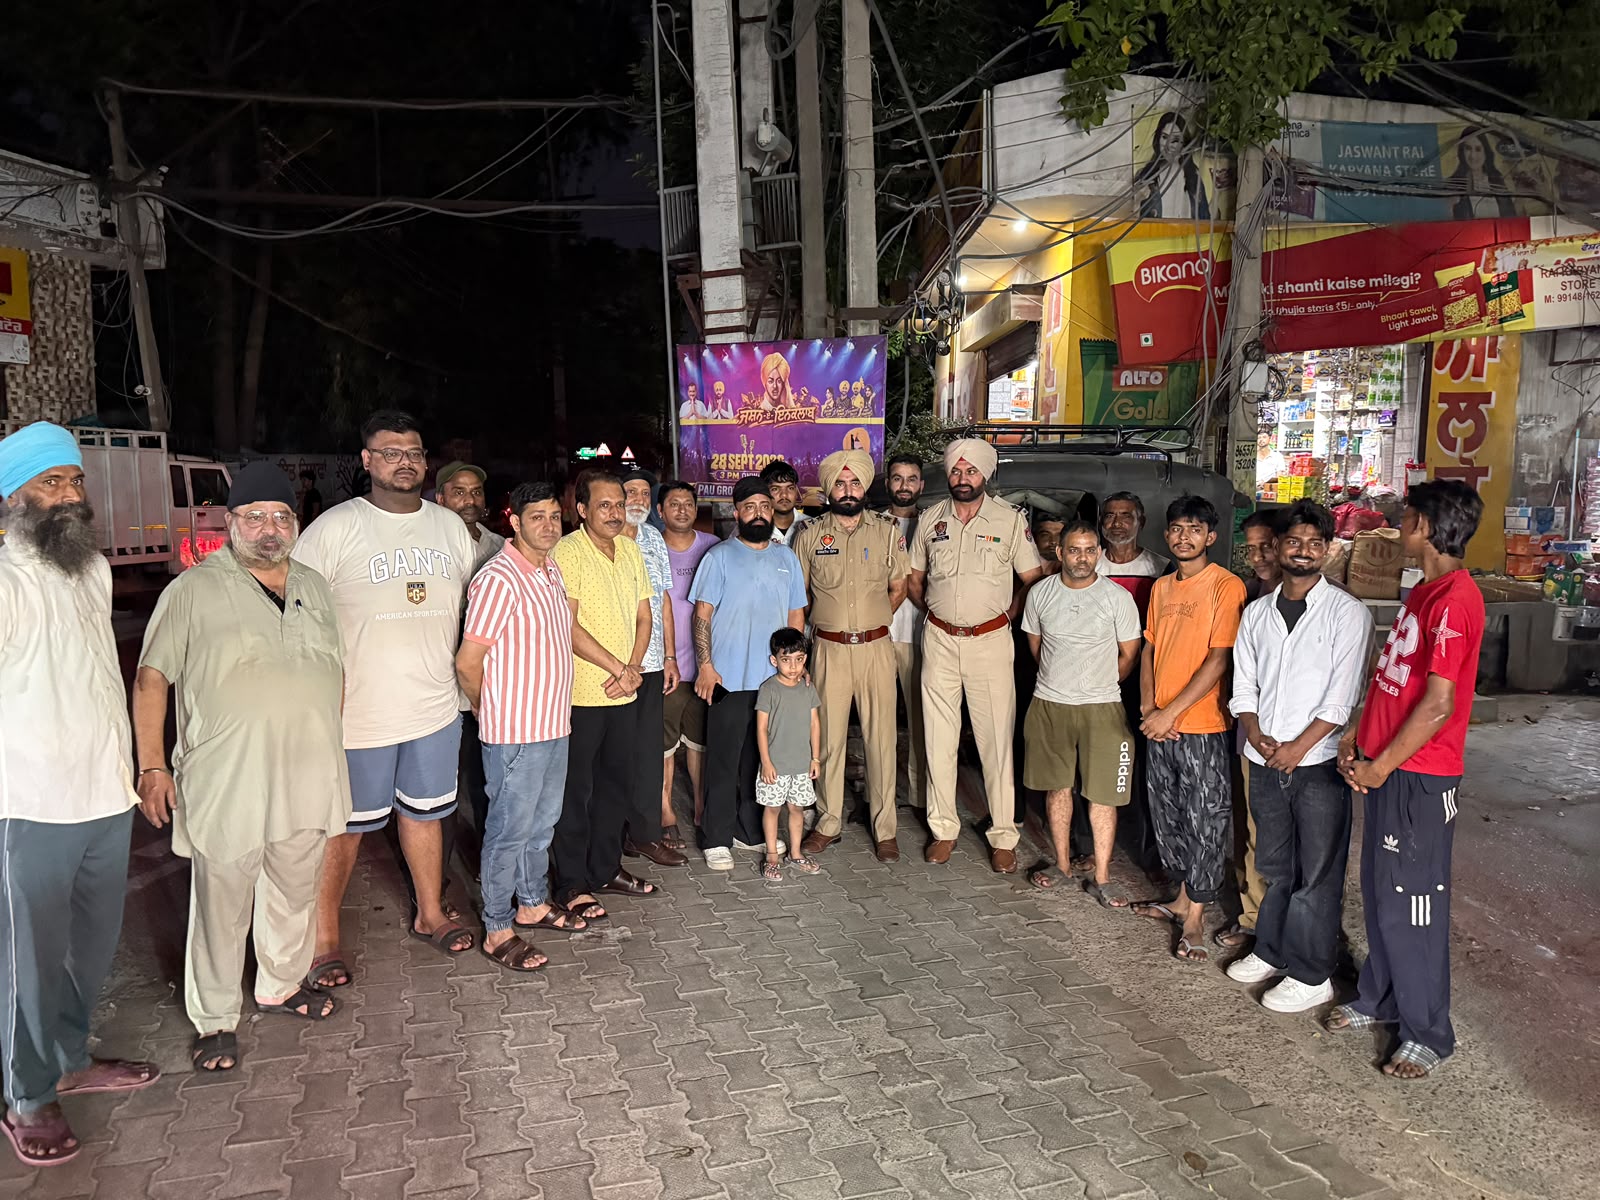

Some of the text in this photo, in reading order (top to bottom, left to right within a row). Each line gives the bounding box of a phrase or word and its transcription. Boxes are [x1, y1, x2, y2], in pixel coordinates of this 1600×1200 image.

[1337, 144, 1424, 159] JASWANT RAI
[1396, 164, 1436, 178] STORE
[1278, 278, 1324, 294] shanti
[1327, 276, 1366, 290] kaise
[1369, 272, 1422, 290] milegi?
[1560, 279, 1596, 291] STORE
[1544, 295, 1555, 304] M:
[1307, 304, 1334, 313] starts
[1380, 304, 1437, 323] Bhaari Sawal,
[1388, 313, 1439, 331] Light Jawab
[1120, 370, 1164, 386] ALTO
[1113, 398, 1169, 420] Gold
[710, 454, 728, 470] 28
[728, 454, 754, 470] SEPT
[698, 484, 734, 496] PAU GRO
[368, 546, 452, 584] GANT
[375, 608, 452, 620] AMERICAN SPORTSWEA
[1116, 742, 1130, 793] adidas
